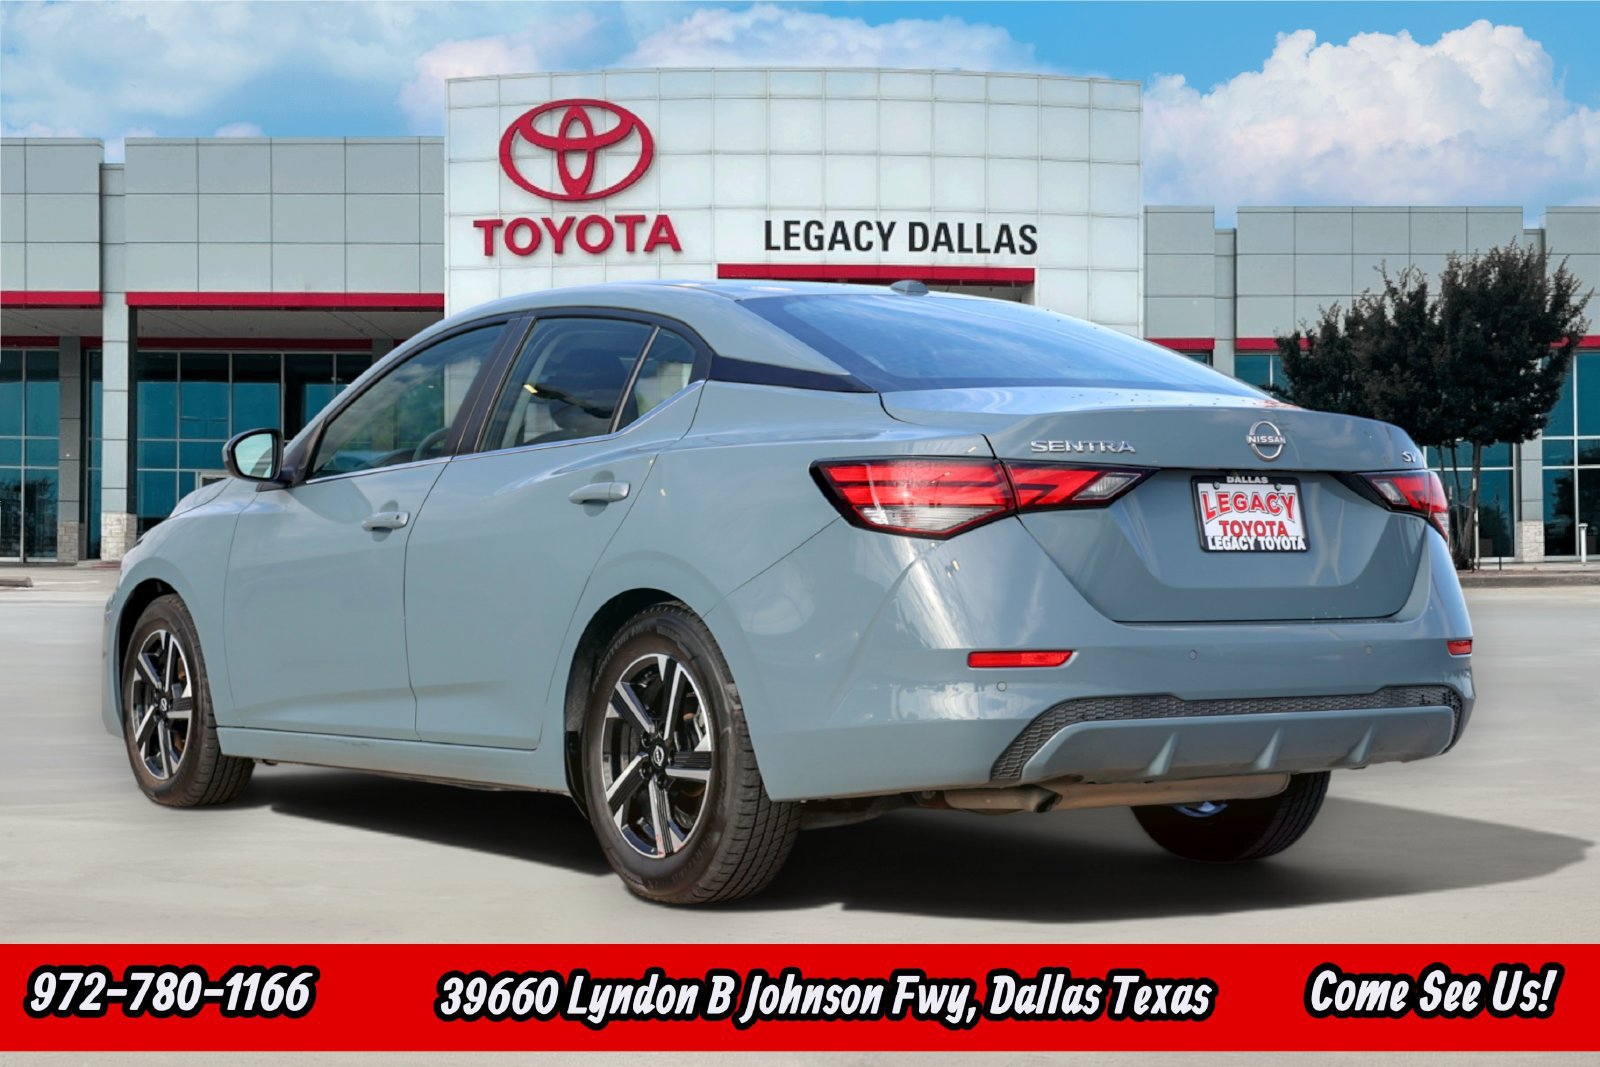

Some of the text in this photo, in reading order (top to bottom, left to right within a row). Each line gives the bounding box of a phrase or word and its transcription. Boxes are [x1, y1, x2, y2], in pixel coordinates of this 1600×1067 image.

[474, 214, 681, 256] TOYOTA
[766, 221, 1037, 254] LEGACY DALLAS
[1030, 439, 1136, 453] SENTRA
[1247, 435, 1286, 444] NISSAN
[1226, 476, 1268, 484] DALLAS
[1201, 491, 1297, 523] LEGACY
[1218, 520, 1289, 537] TOYOTA
[1207, 536, 1307, 550] LEGACY TOYOTA
